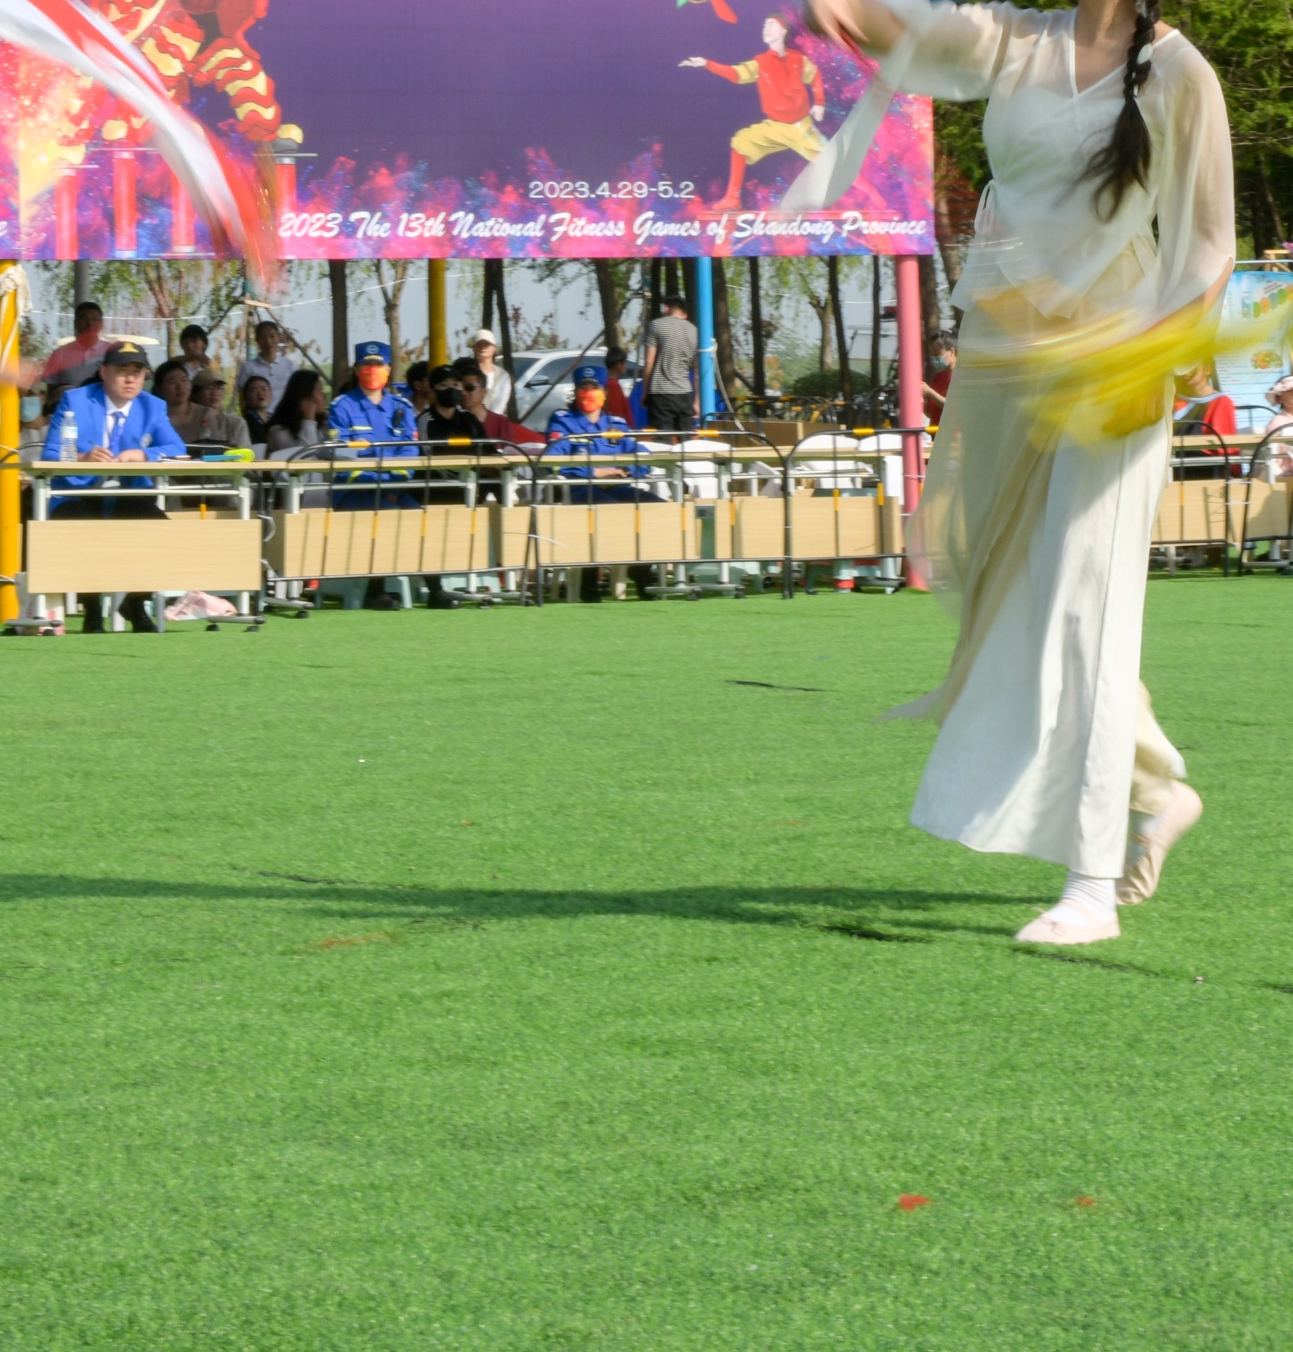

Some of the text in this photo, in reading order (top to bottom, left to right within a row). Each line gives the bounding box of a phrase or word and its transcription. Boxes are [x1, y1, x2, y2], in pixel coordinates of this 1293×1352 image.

[528, 180, 696, 200] 2023.4.29-5.2
[278, 210, 927, 245] 2023 The 13th National Fitness Games of Shandong Province
